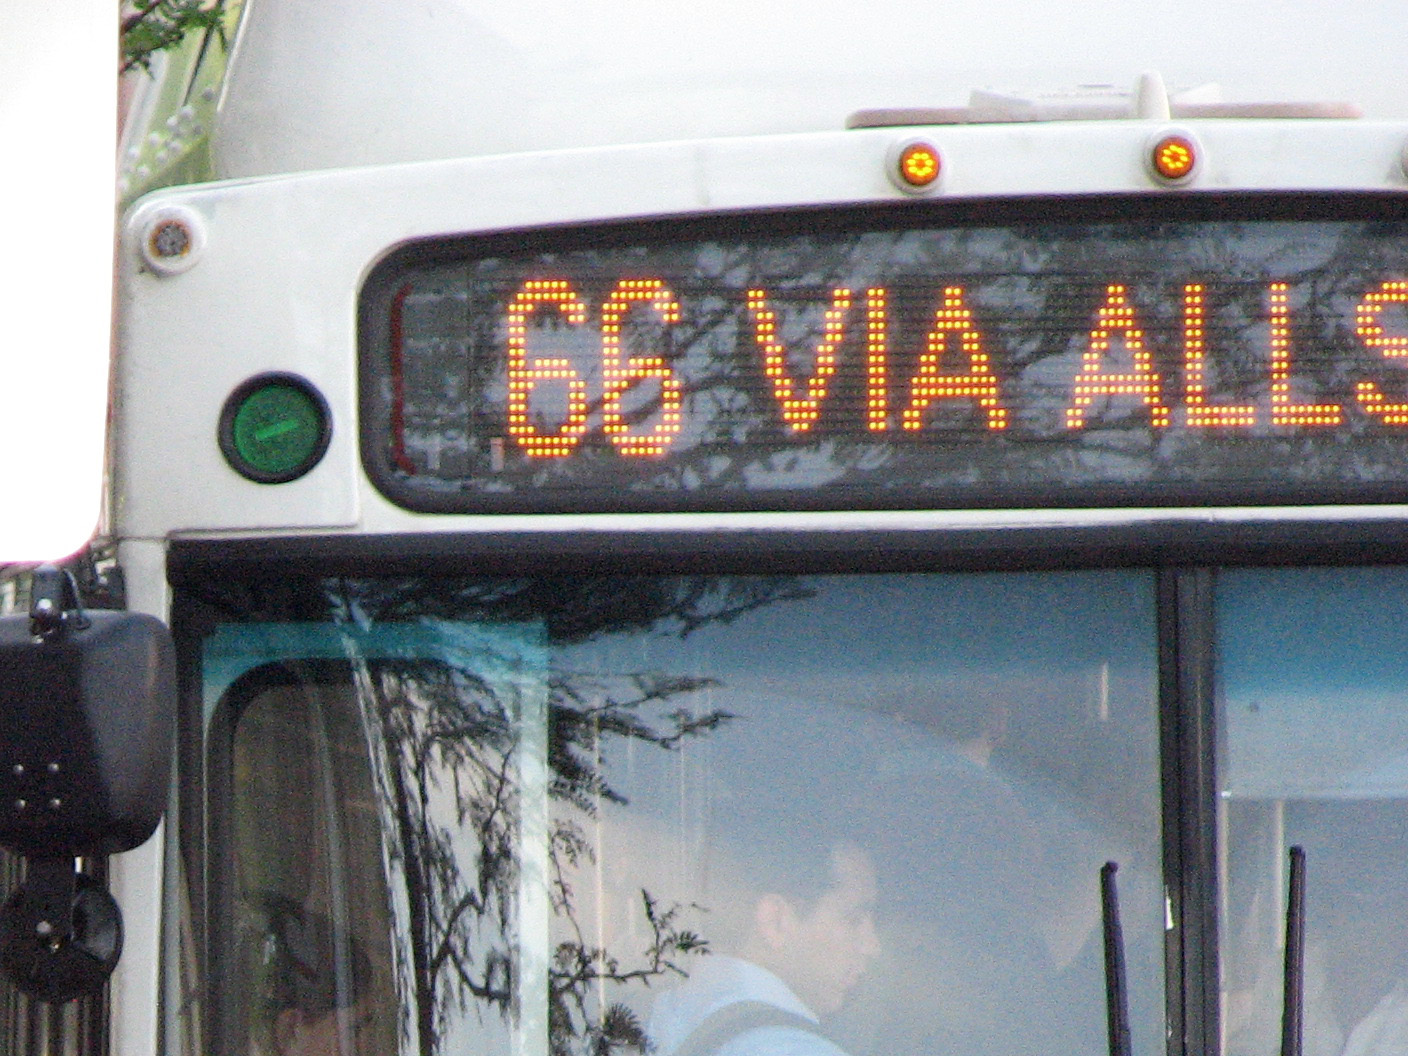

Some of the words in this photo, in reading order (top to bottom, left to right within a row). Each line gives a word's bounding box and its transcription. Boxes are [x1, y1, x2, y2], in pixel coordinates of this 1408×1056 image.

[507, 279, 681, 459] 66
[747, 284, 1008, 433] VIA
[1070, 280, 1408, 429] ALLS
